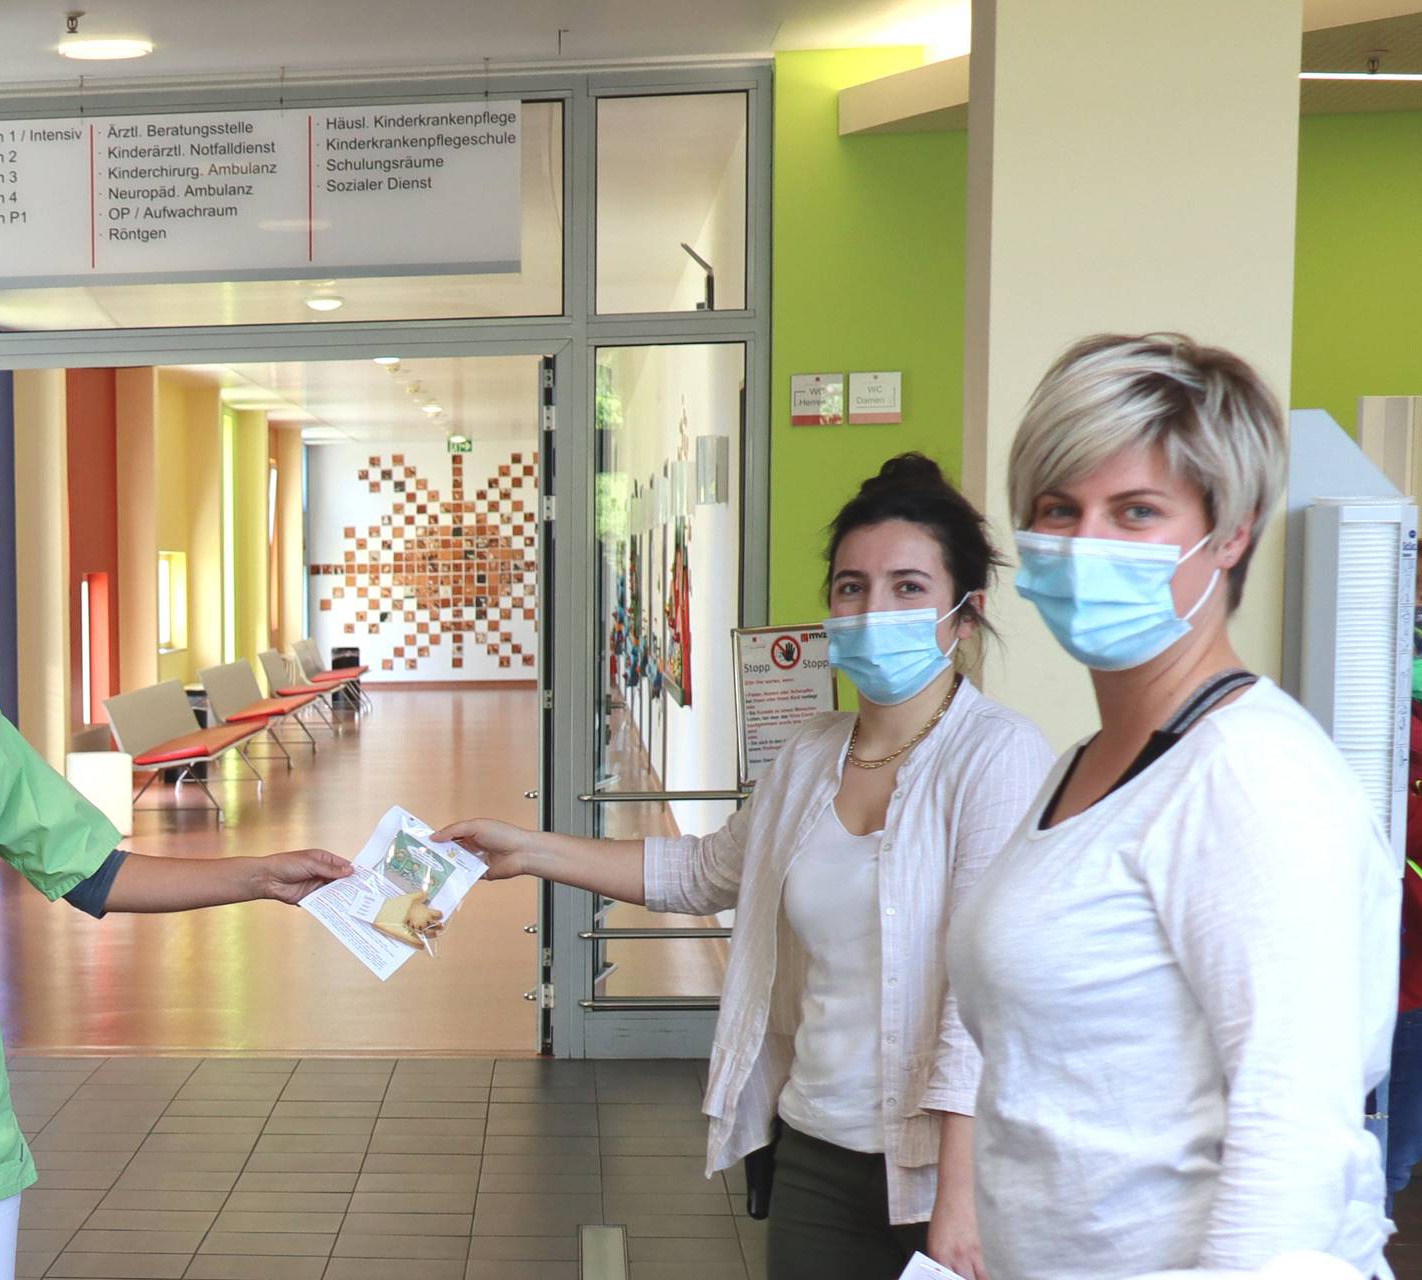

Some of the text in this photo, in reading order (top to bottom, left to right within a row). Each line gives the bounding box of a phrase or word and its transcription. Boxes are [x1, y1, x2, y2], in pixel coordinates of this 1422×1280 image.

[326, 111, 516, 130] Häusl. Kinderkrankenpflege
[9, 131, 17, 142] 1
[29, 128, 82, 142] Intensiv
[107, 122, 254, 138] Ärztl. Beratungsstelle
[326, 132, 516, 151] Kinderkrankenpflegeschule
[9, 151, 17, 163] 2
[107, 141, 276, 159] Kinderärztl. Notfalldienst
[108, 162, 278, 180] Kinderchirurg. Ambulanz
[326, 155, 444, 173] Schulungsräume
[9, 171, 17, 183] 3
[326, 177, 432, 192] Sozialer Dienst
[9, 192, 17, 203] 4
[108, 183, 253, 201] Neuropäd. Ambulanz
[9, 211, 27, 224] P1
[108, 207, 131, 221] OP
[143, 205, 238, 219] Aufwachraum
[109, 228, 167, 243] Röntgen
[867, 385, 883, 393] WC
[856, 396, 886, 405] Damen
[744, 663, 771, 674] Stopp
[802, 659, 829, 670] Stopp
